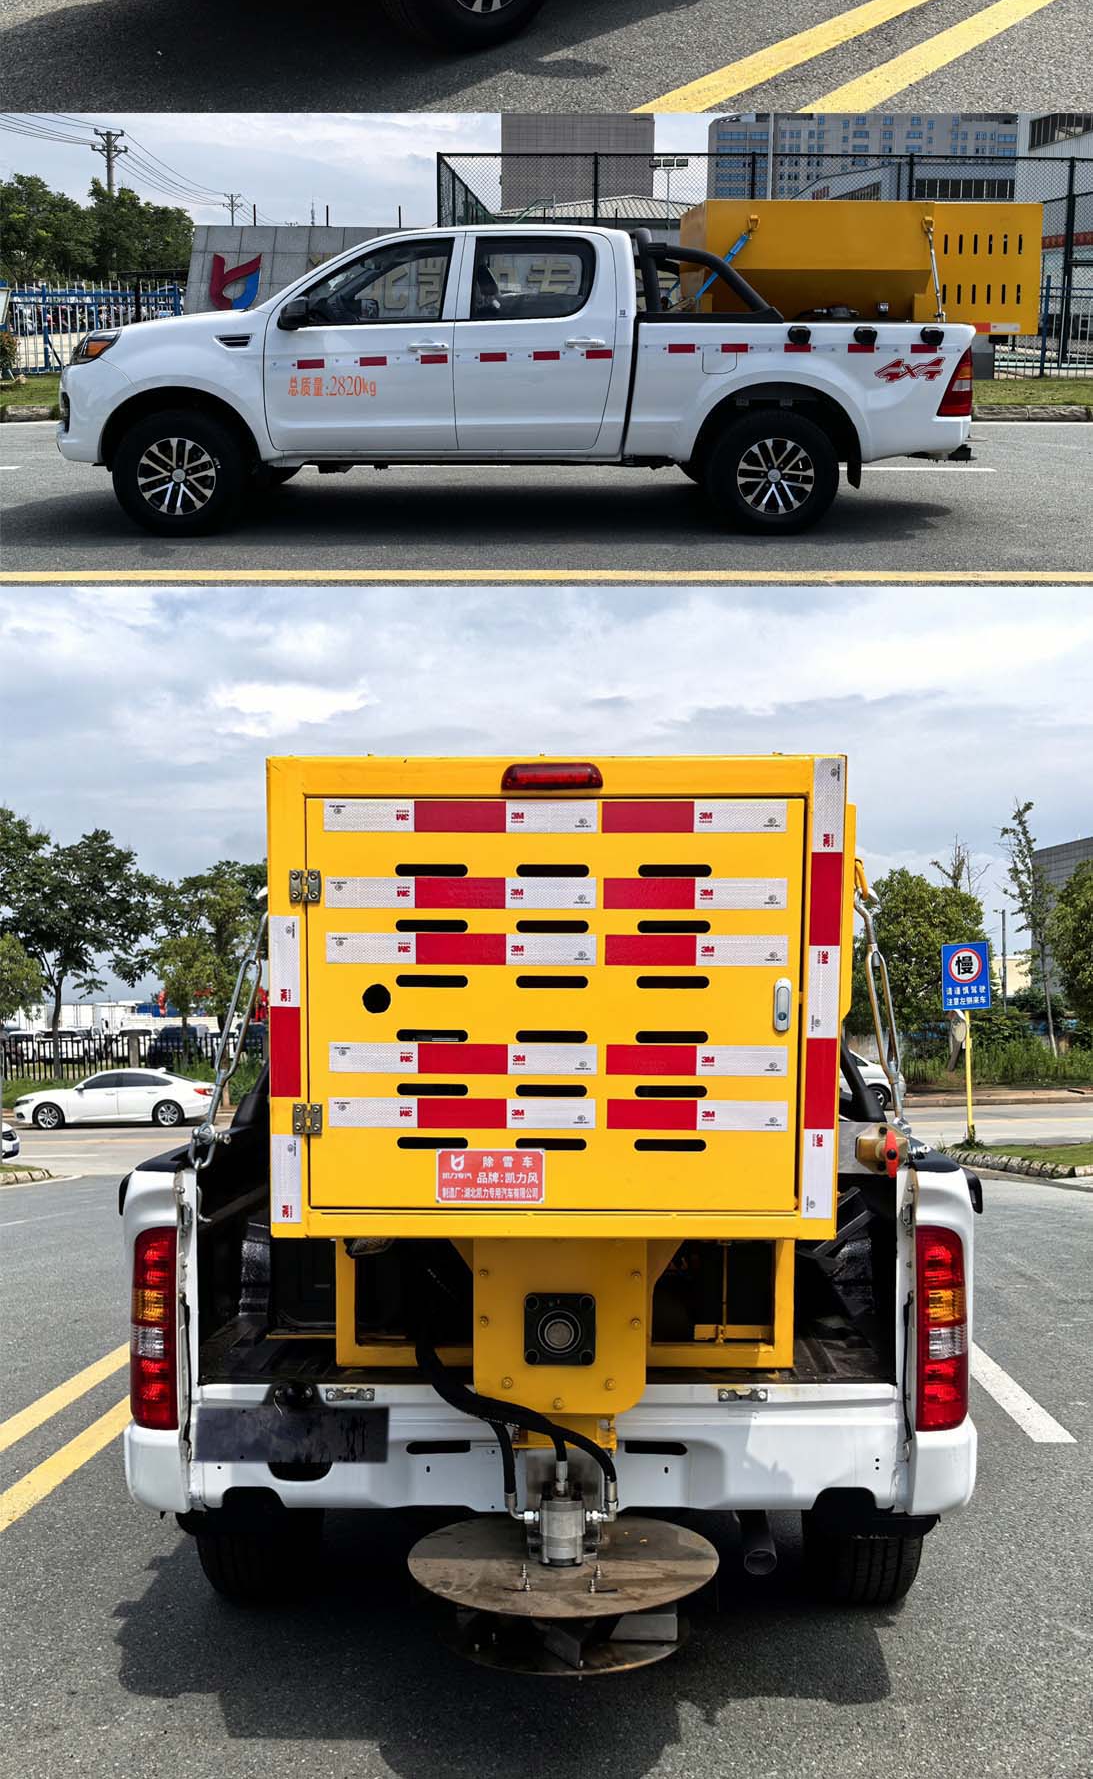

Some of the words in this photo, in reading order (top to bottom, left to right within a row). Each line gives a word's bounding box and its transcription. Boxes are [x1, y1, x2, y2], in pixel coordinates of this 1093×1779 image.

[396, 813, 410, 821] 3M
[511, 812, 525, 820] 3M
[699, 812, 713, 820] 3M
[823, 833, 830, 848] 3M
[396, 890, 411, 898] 3M
[510, 889, 525, 897] 3M
[700, 889, 714, 897] 3M
[398, 945, 411, 953] 3M
[511, 945, 525, 953] 3M
[701, 946, 715, 954] 3M
[821, 951, 829, 964] 3M
[955, 955, 974, 975] 慢
[281, 989, 288, 1002] 3M
[400, 1055, 414, 1063] 3M
[512, 1055, 526, 1063] 3M
[701, 1056, 715, 1064] 3M
[399, 1109, 413, 1117] 3M
[511, 1109, 525, 1117] 3M
[701, 1111, 716, 1119] 3M
[816, 1134, 823, 1148] 3M
[482, 1155, 533, 1168] 除雪车
[282, 1205, 290, 1218] 3M
